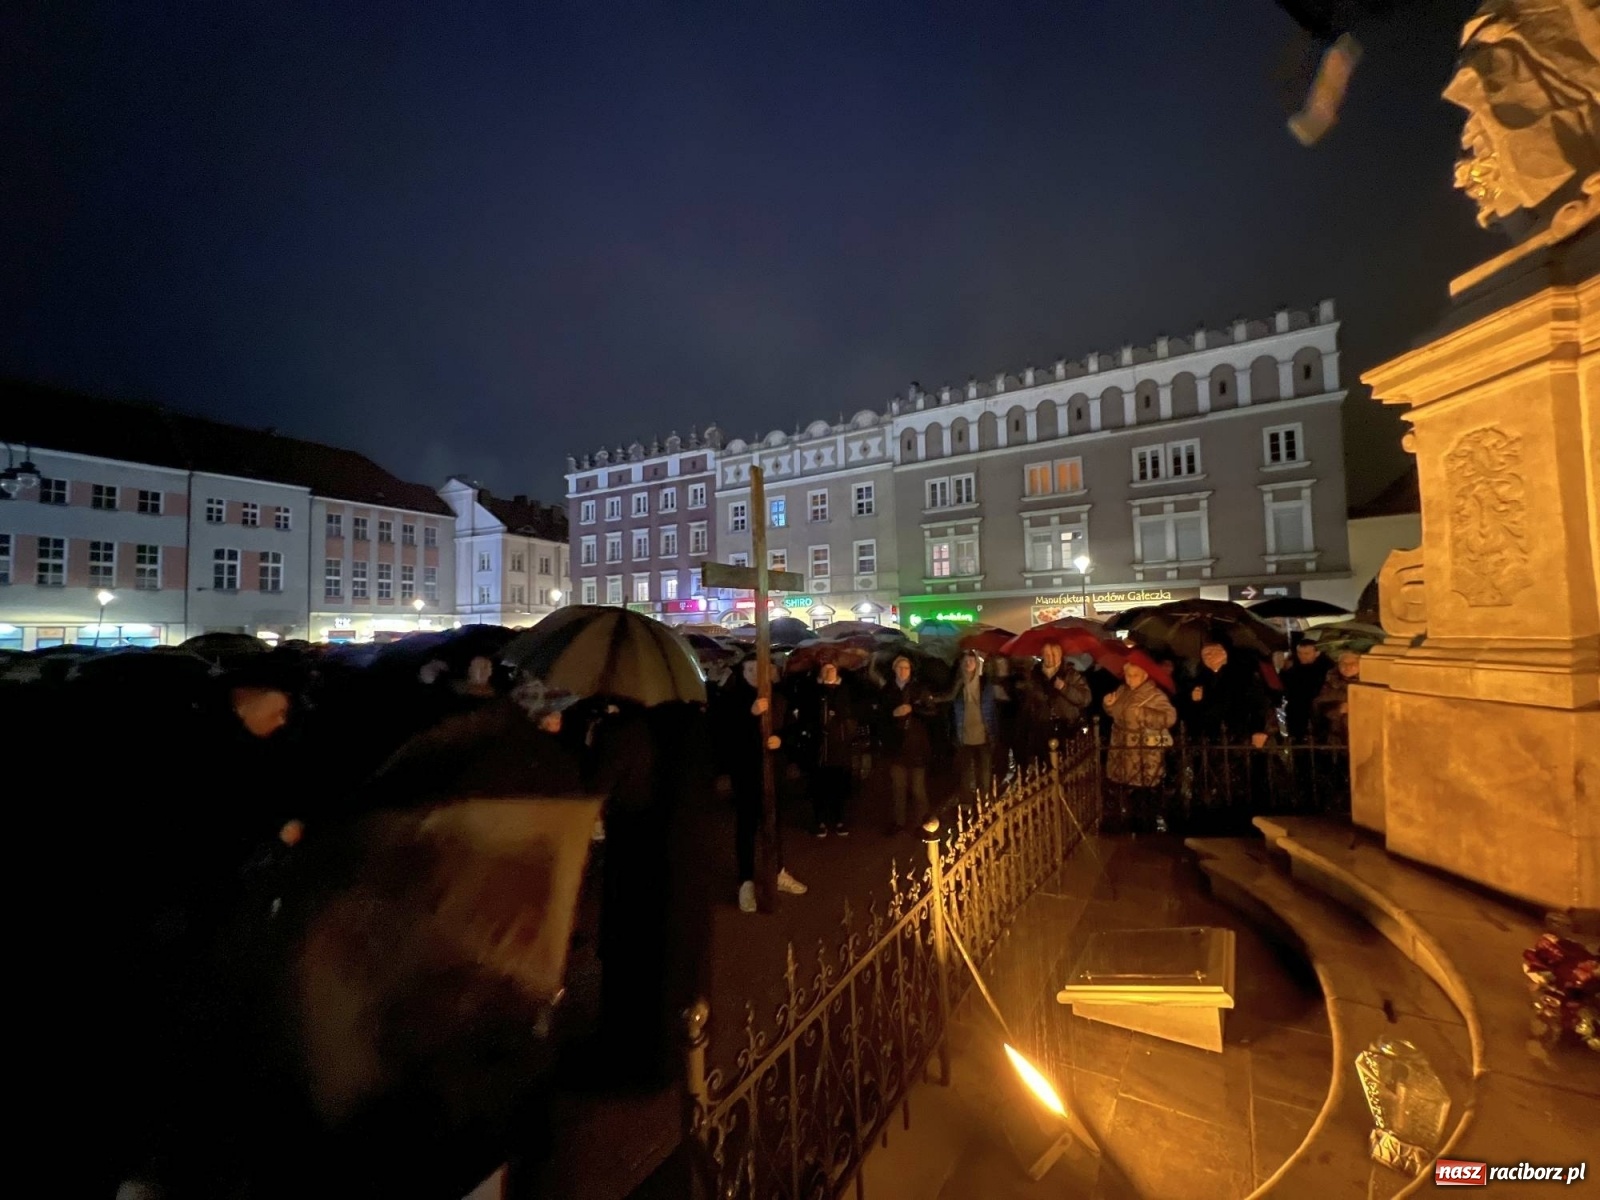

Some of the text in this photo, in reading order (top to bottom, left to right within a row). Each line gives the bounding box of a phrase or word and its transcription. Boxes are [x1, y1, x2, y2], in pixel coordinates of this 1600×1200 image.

[785, 597, 813, 608] SHIRO
[1035, 590, 1171, 605] Manufaktura Lodów Gałeczka
